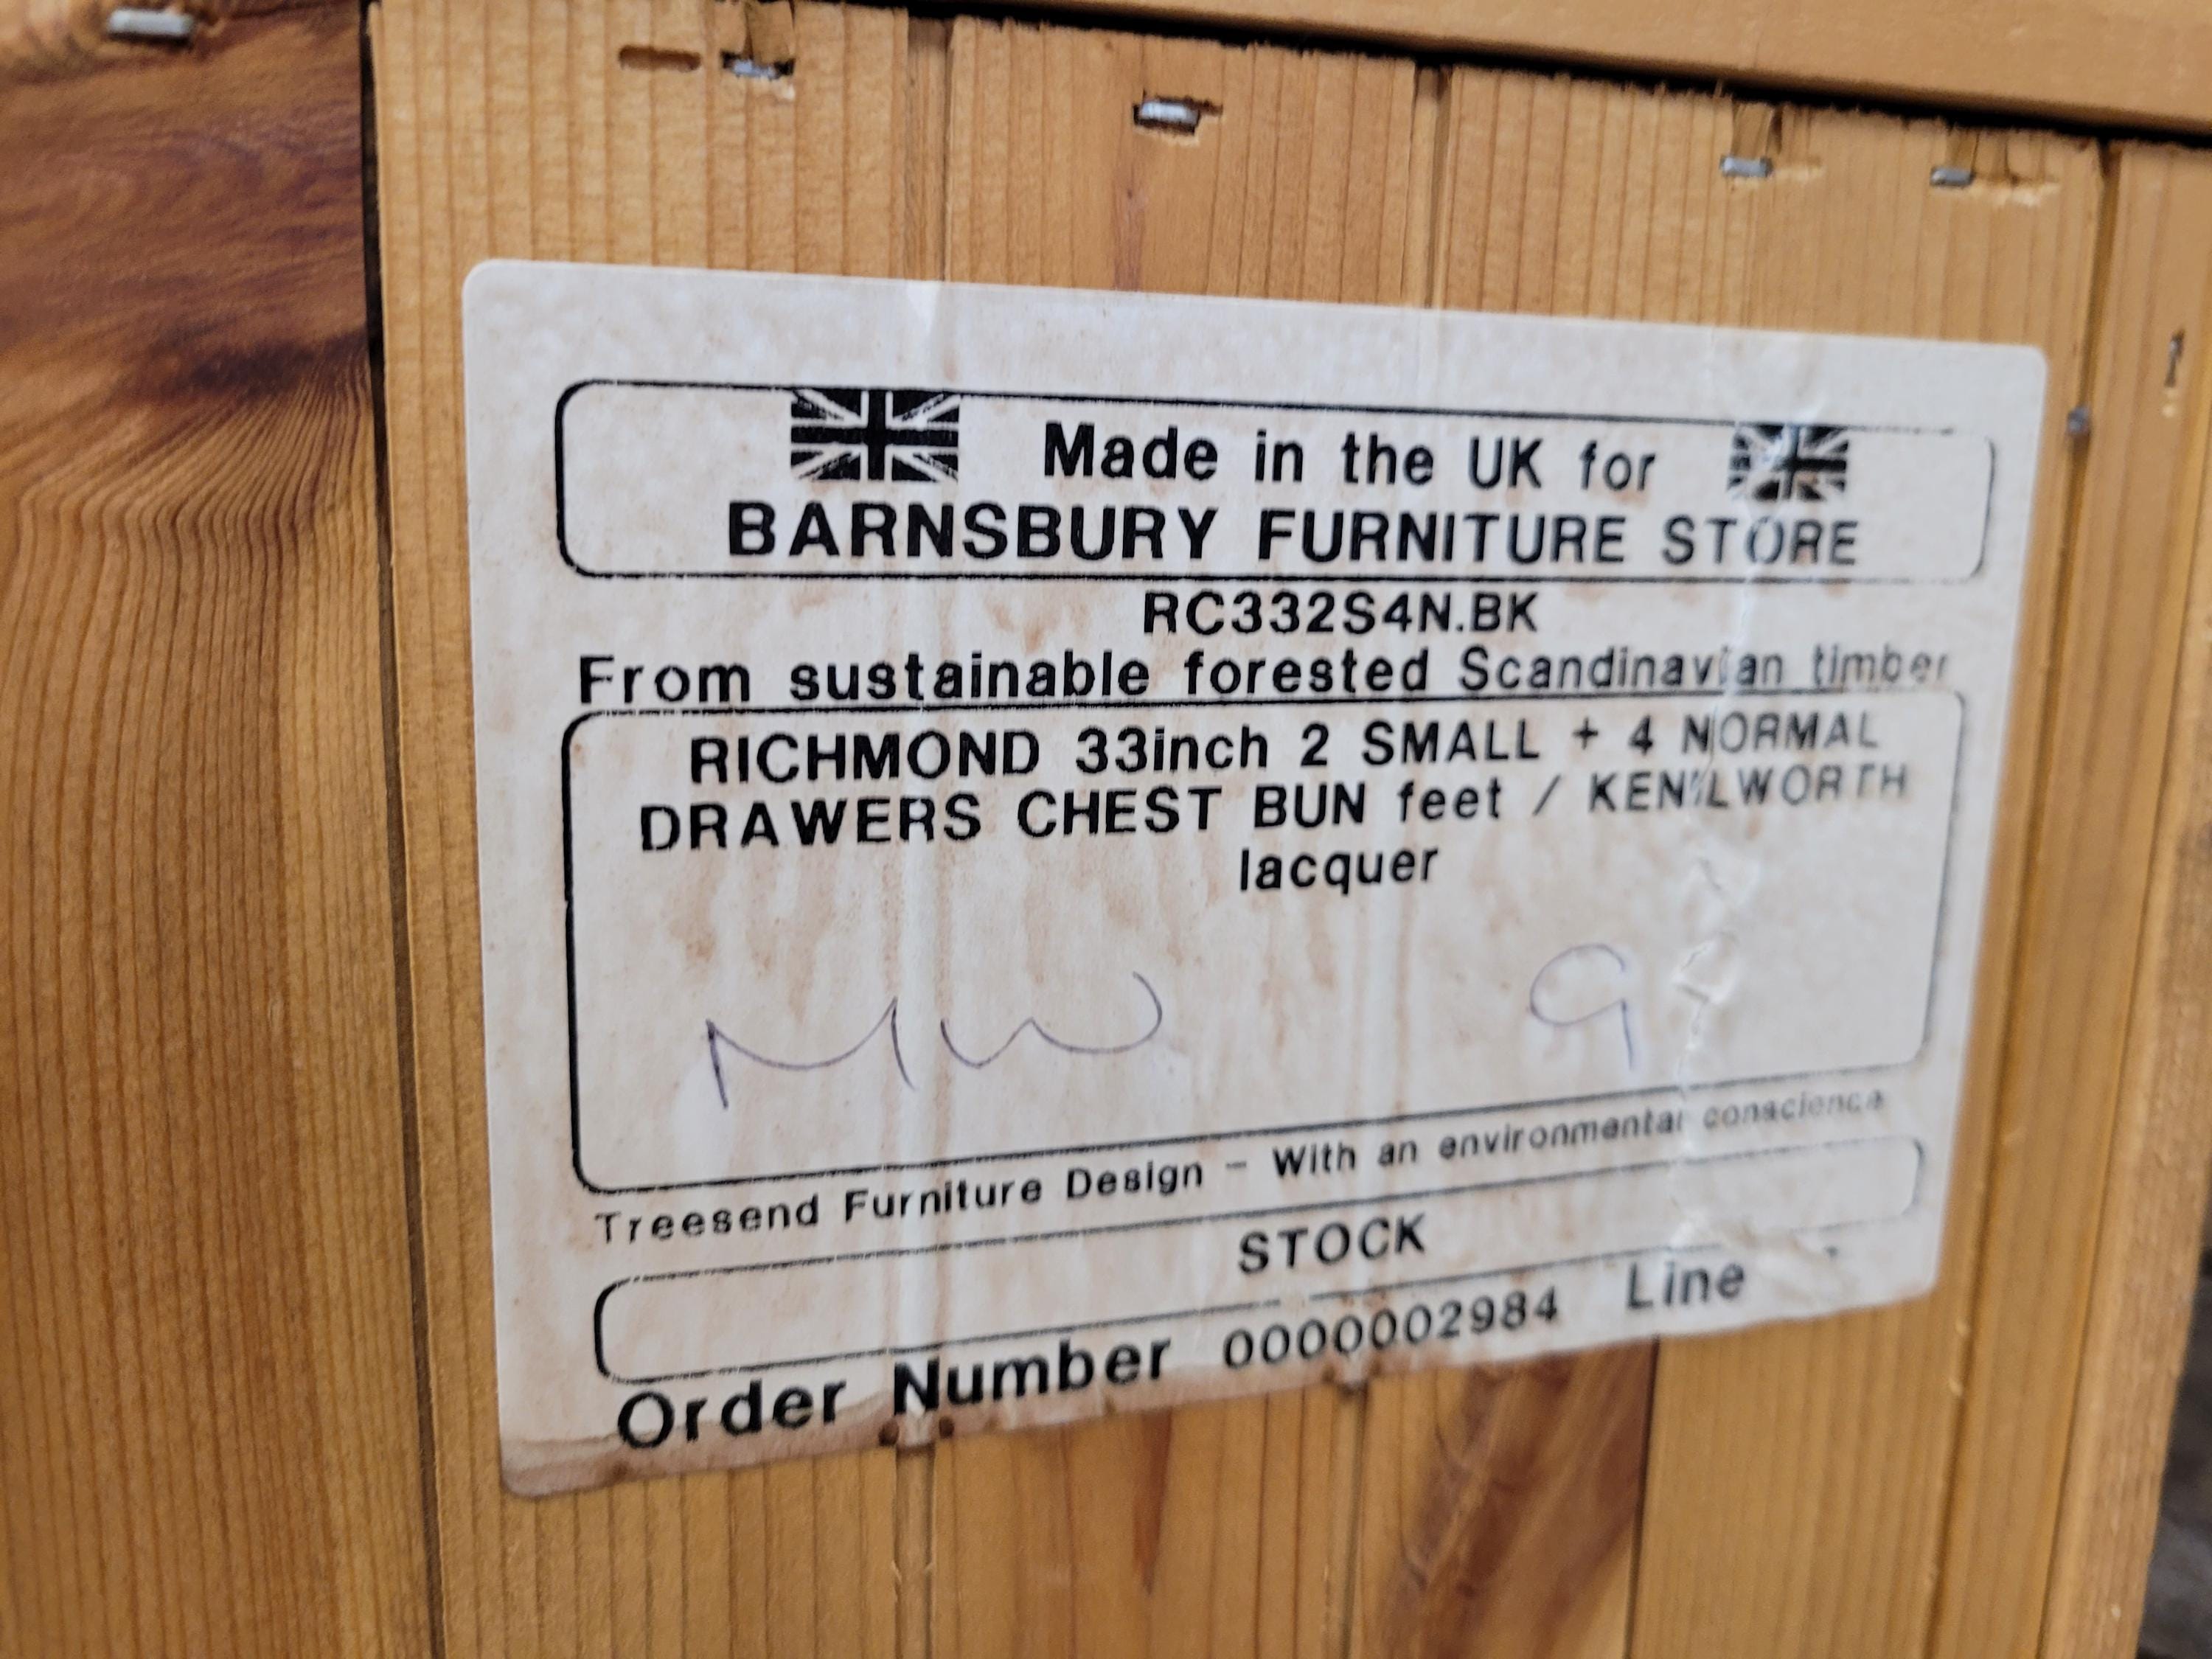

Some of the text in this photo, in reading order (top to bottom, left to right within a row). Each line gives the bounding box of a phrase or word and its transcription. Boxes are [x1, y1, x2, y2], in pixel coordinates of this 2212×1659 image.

[1044, 421, 1656, 491] Made in the UK for
[728, 501, 1860, 566] BARNSBURY FURNITURE STORE
[1144, 591, 1539, 635] RC332S4N.BK
[579, 641, 1950, 704] From sustainable forested Scandinavian timber
[690, 711, 1879, 785] RICHMOND 33inch 2 SMALL + 4 NORMAL
[641, 792, 981, 852] DRAWERS
[1018, 785, 1222, 838] CHEST
[1254, 782, 1366, 828] BUN
[1399, 776, 1502, 822] feet
[1532, 775, 1562, 817] /
[1239, 844, 1439, 895] lacquer
[594, 1194, 819, 1245] Treesend
[844, 1178, 1043, 1223] Furniture
[1066, 1160, 1204, 1200] Design
[1273, 1146, 1356, 1179] With
[1377, 1139, 1418, 1166] an
[1439, 1110, 1683, 1161] environmental
[1238, 1214, 1427, 1273] STOCK
[618, 1257, 1745, 1450] Order Number 0000002984 Line
